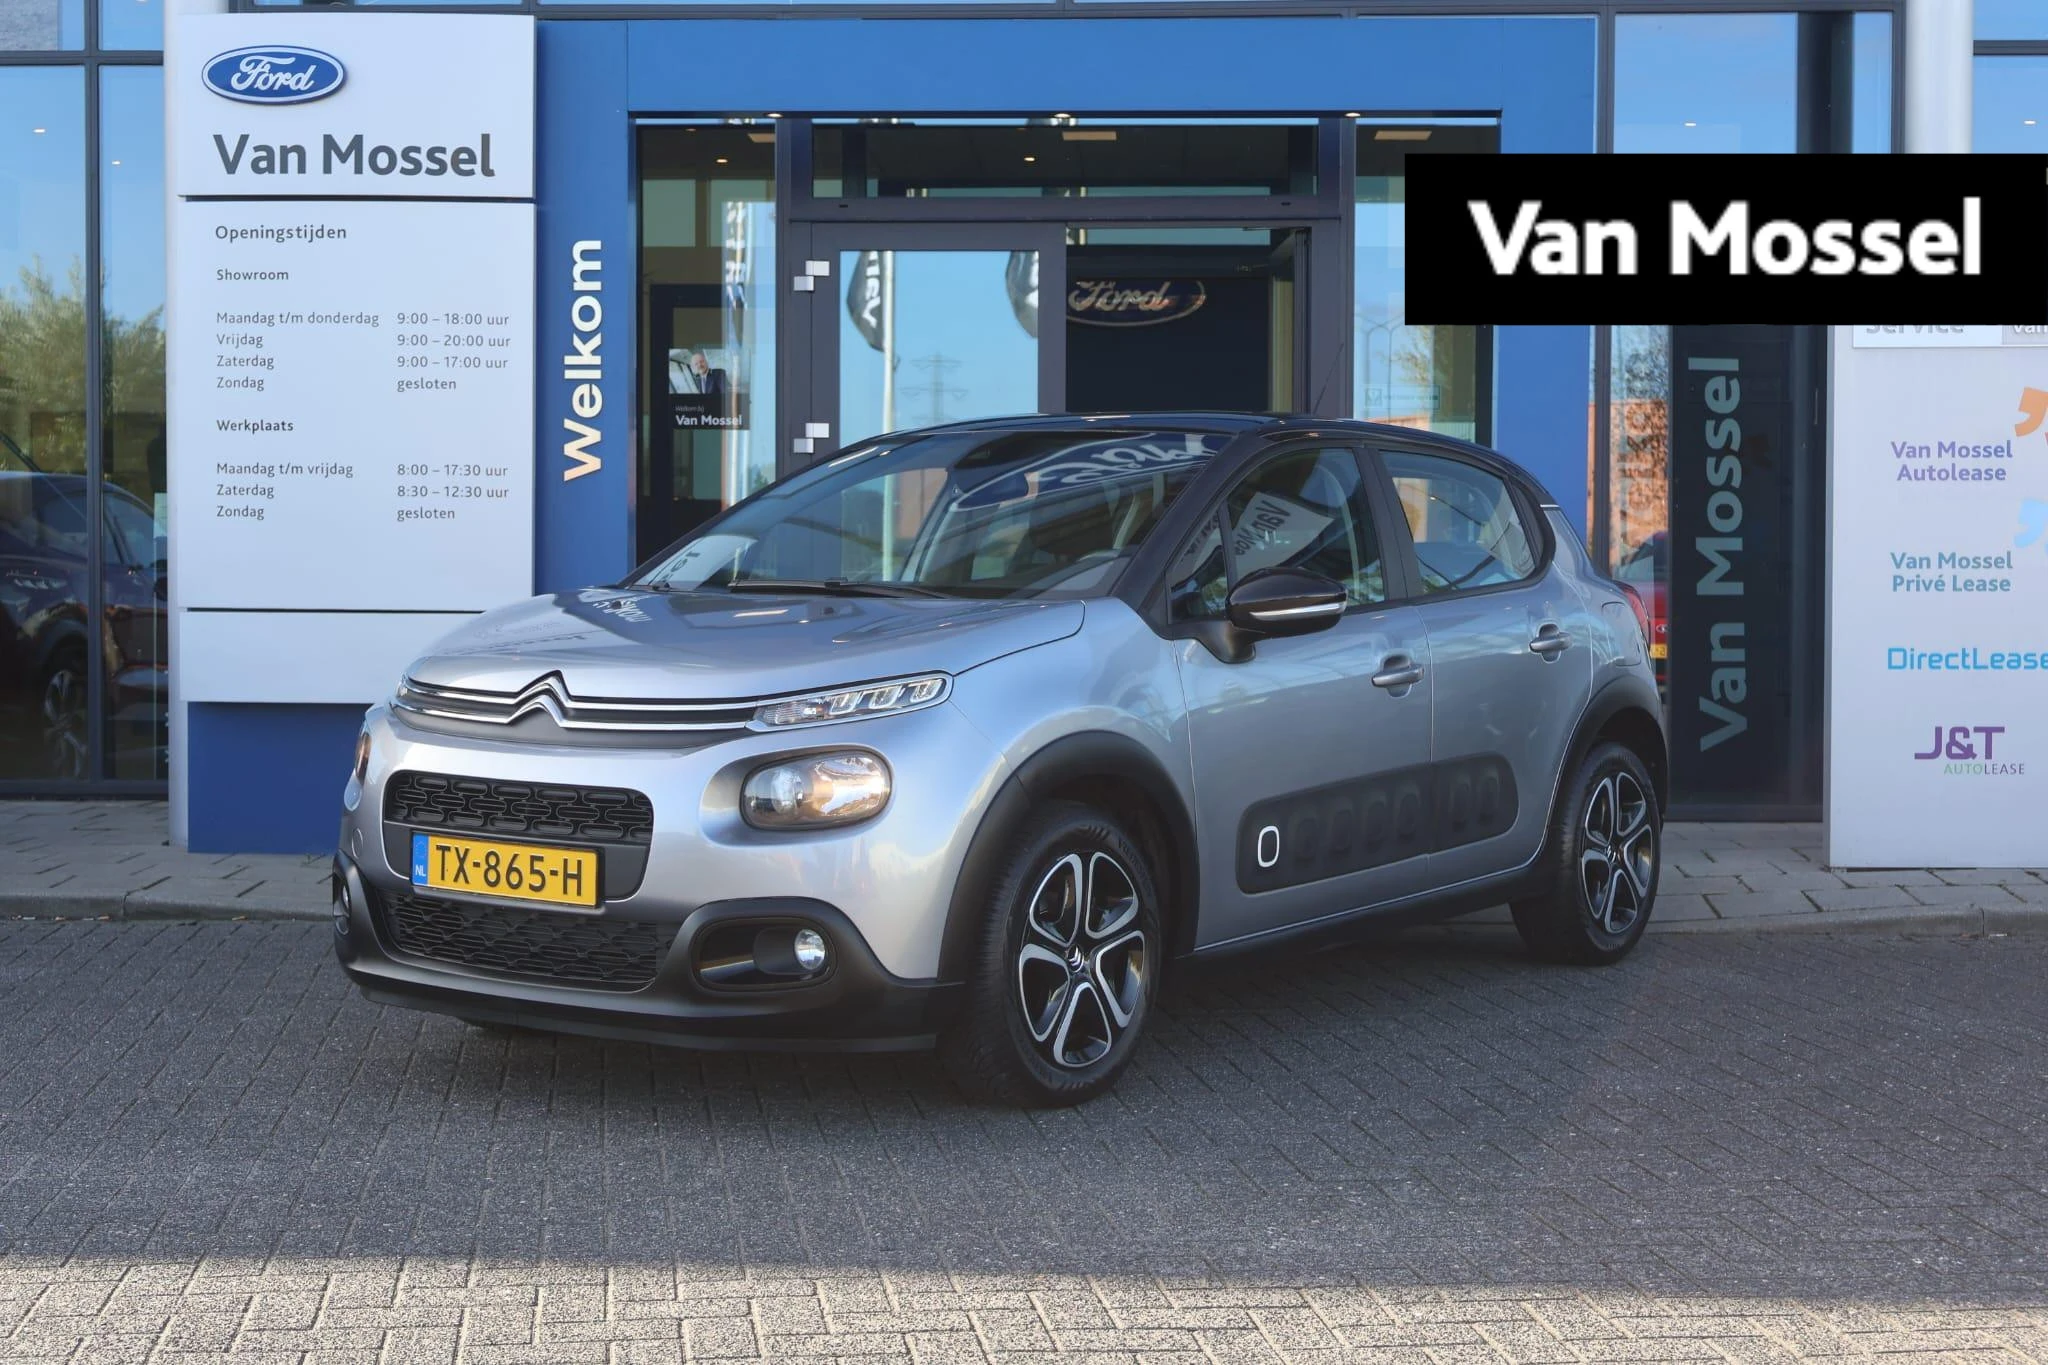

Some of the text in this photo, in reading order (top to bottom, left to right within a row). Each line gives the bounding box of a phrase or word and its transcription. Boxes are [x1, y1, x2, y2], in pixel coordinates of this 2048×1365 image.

[231, 54, 317, 92] Ford
[213, 132, 495, 177] Van Mossel
[215, 224, 347, 244] Openingstijden
[216, 268, 290, 281] Showroom
[1068, 281, 1171, 311] Ford
[216, 311, 380, 328] Maandag t/m donderdag
[397, 312, 429, 326] 9:00
[444, 312, 483, 327] 18:00
[487, 315, 510, 326] uur
[216, 332, 264, 350] Vrijdag
[397, 333, 429, 347] 9:00
[443, 334, 484, 348] 20:00
[488, 337, 512, 347] uur
[216, 354, 275, 371] Zaterdag
[397, 355, 429, 369] 9:00
[444, 355, 482, 369] 17:00
[486, 359, 509, 369] uur
[563, 240, 603, 482] Welkom
[216, 375, 265, 392] Zondag
[396, 376, 457, 393] gesloten
[216, 418, 294, 435] Werkplaats
[675, 414, 743, 426] Van Mossel
[1890, 440, 2014, 459] Van Mossel
[216, 461, 354, 479] Maandag t/m vrijdag
[397, 463, 429, 477] 8:00
[444, 464, 482, 478] 17:30
[485, 467, 509, 477] uur
[1896, 462, 2008, 482] Autolease
[216, 483, 275, 500] Zaterdag
[397, 485, 429, 498] 8:30
[443, 485, 482, 499] 12:30
[486, 489, 510, 498] uur
[216, 505, 265, 521] Zondag
[396, 506, 456, 523] gesloten
[1687, 357, 1748, 752] Van Mossel
[1889, 550, 2014, 570] Van Mossel
[1892, 573, 2012, 593] Privé Lease
[1913, 725, 2006, 761] J&T
[1943, 763, 2025, 776] AUTOLEASE
[414, 865, 427, 877] NL
[435, 844, 583, 897] TX-865-H
